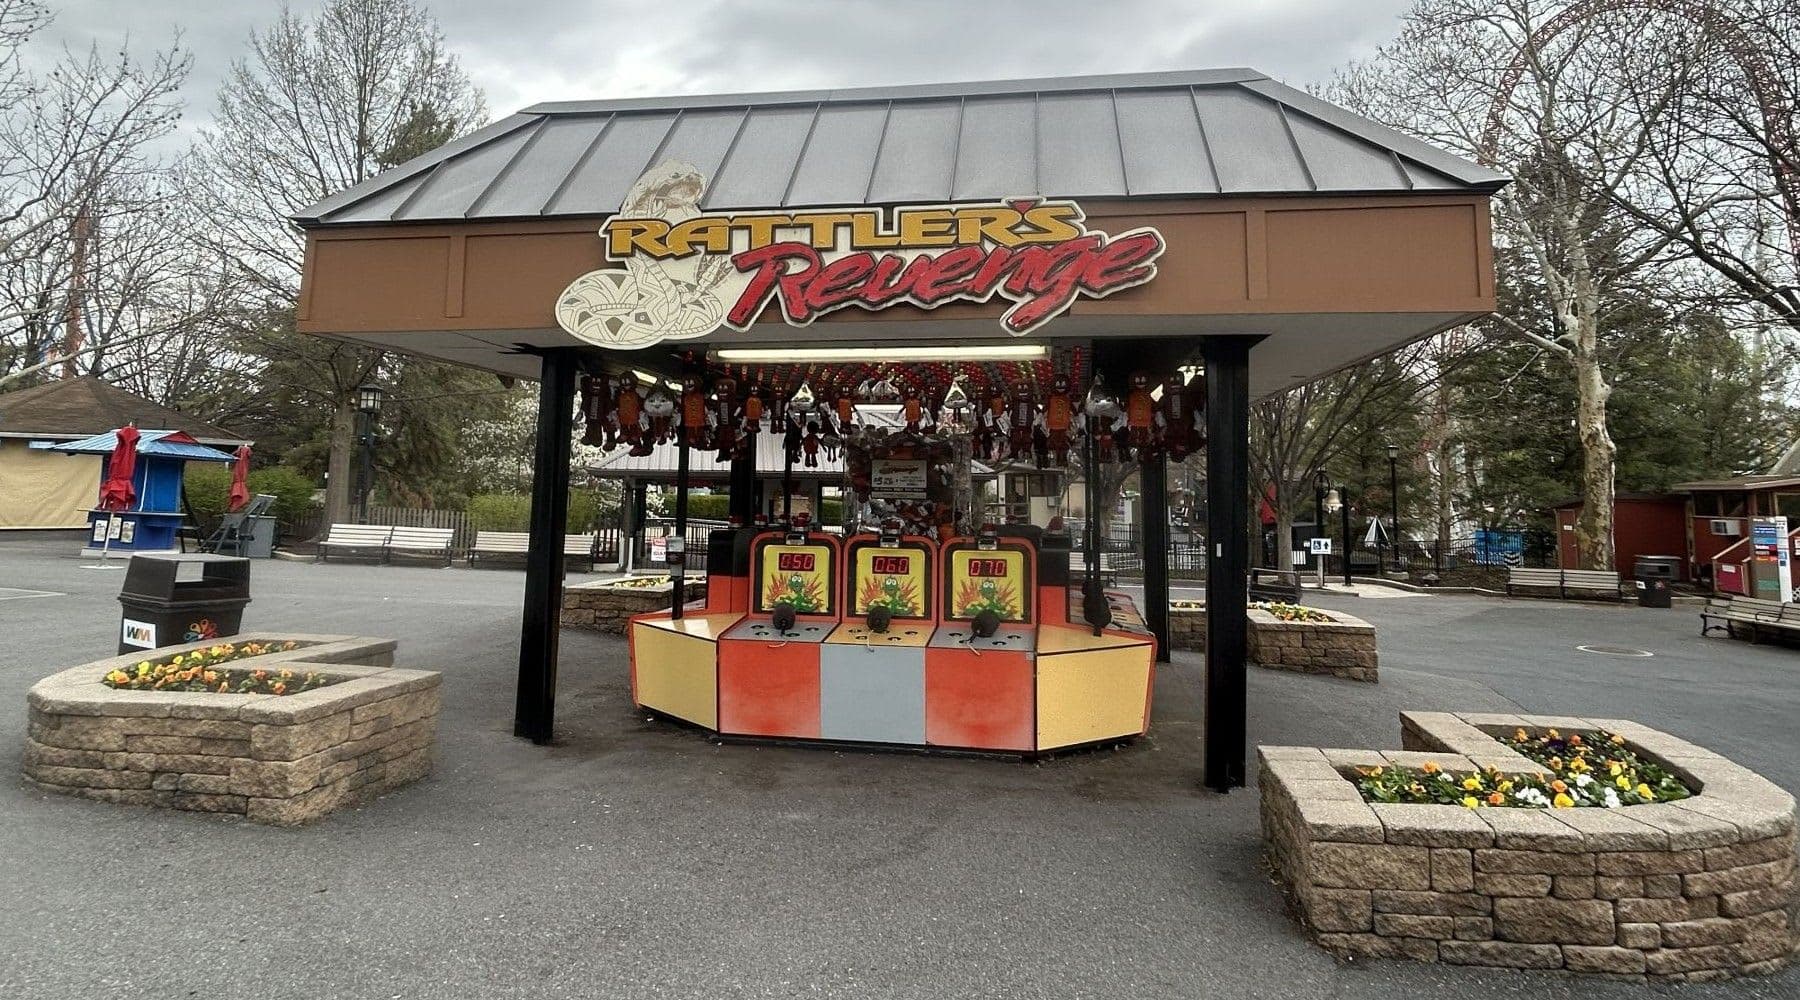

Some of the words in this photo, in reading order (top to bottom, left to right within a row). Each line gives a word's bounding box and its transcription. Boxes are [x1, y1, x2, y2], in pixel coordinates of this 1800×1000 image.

[608, 200, 1081, 257] RATTLER'S
[726, 232, 1160, 331] Revenge
[780, 554, 814, 569] 050
[970, 560, 1006, 576] 070
[126, 624, 151, 642] WM
